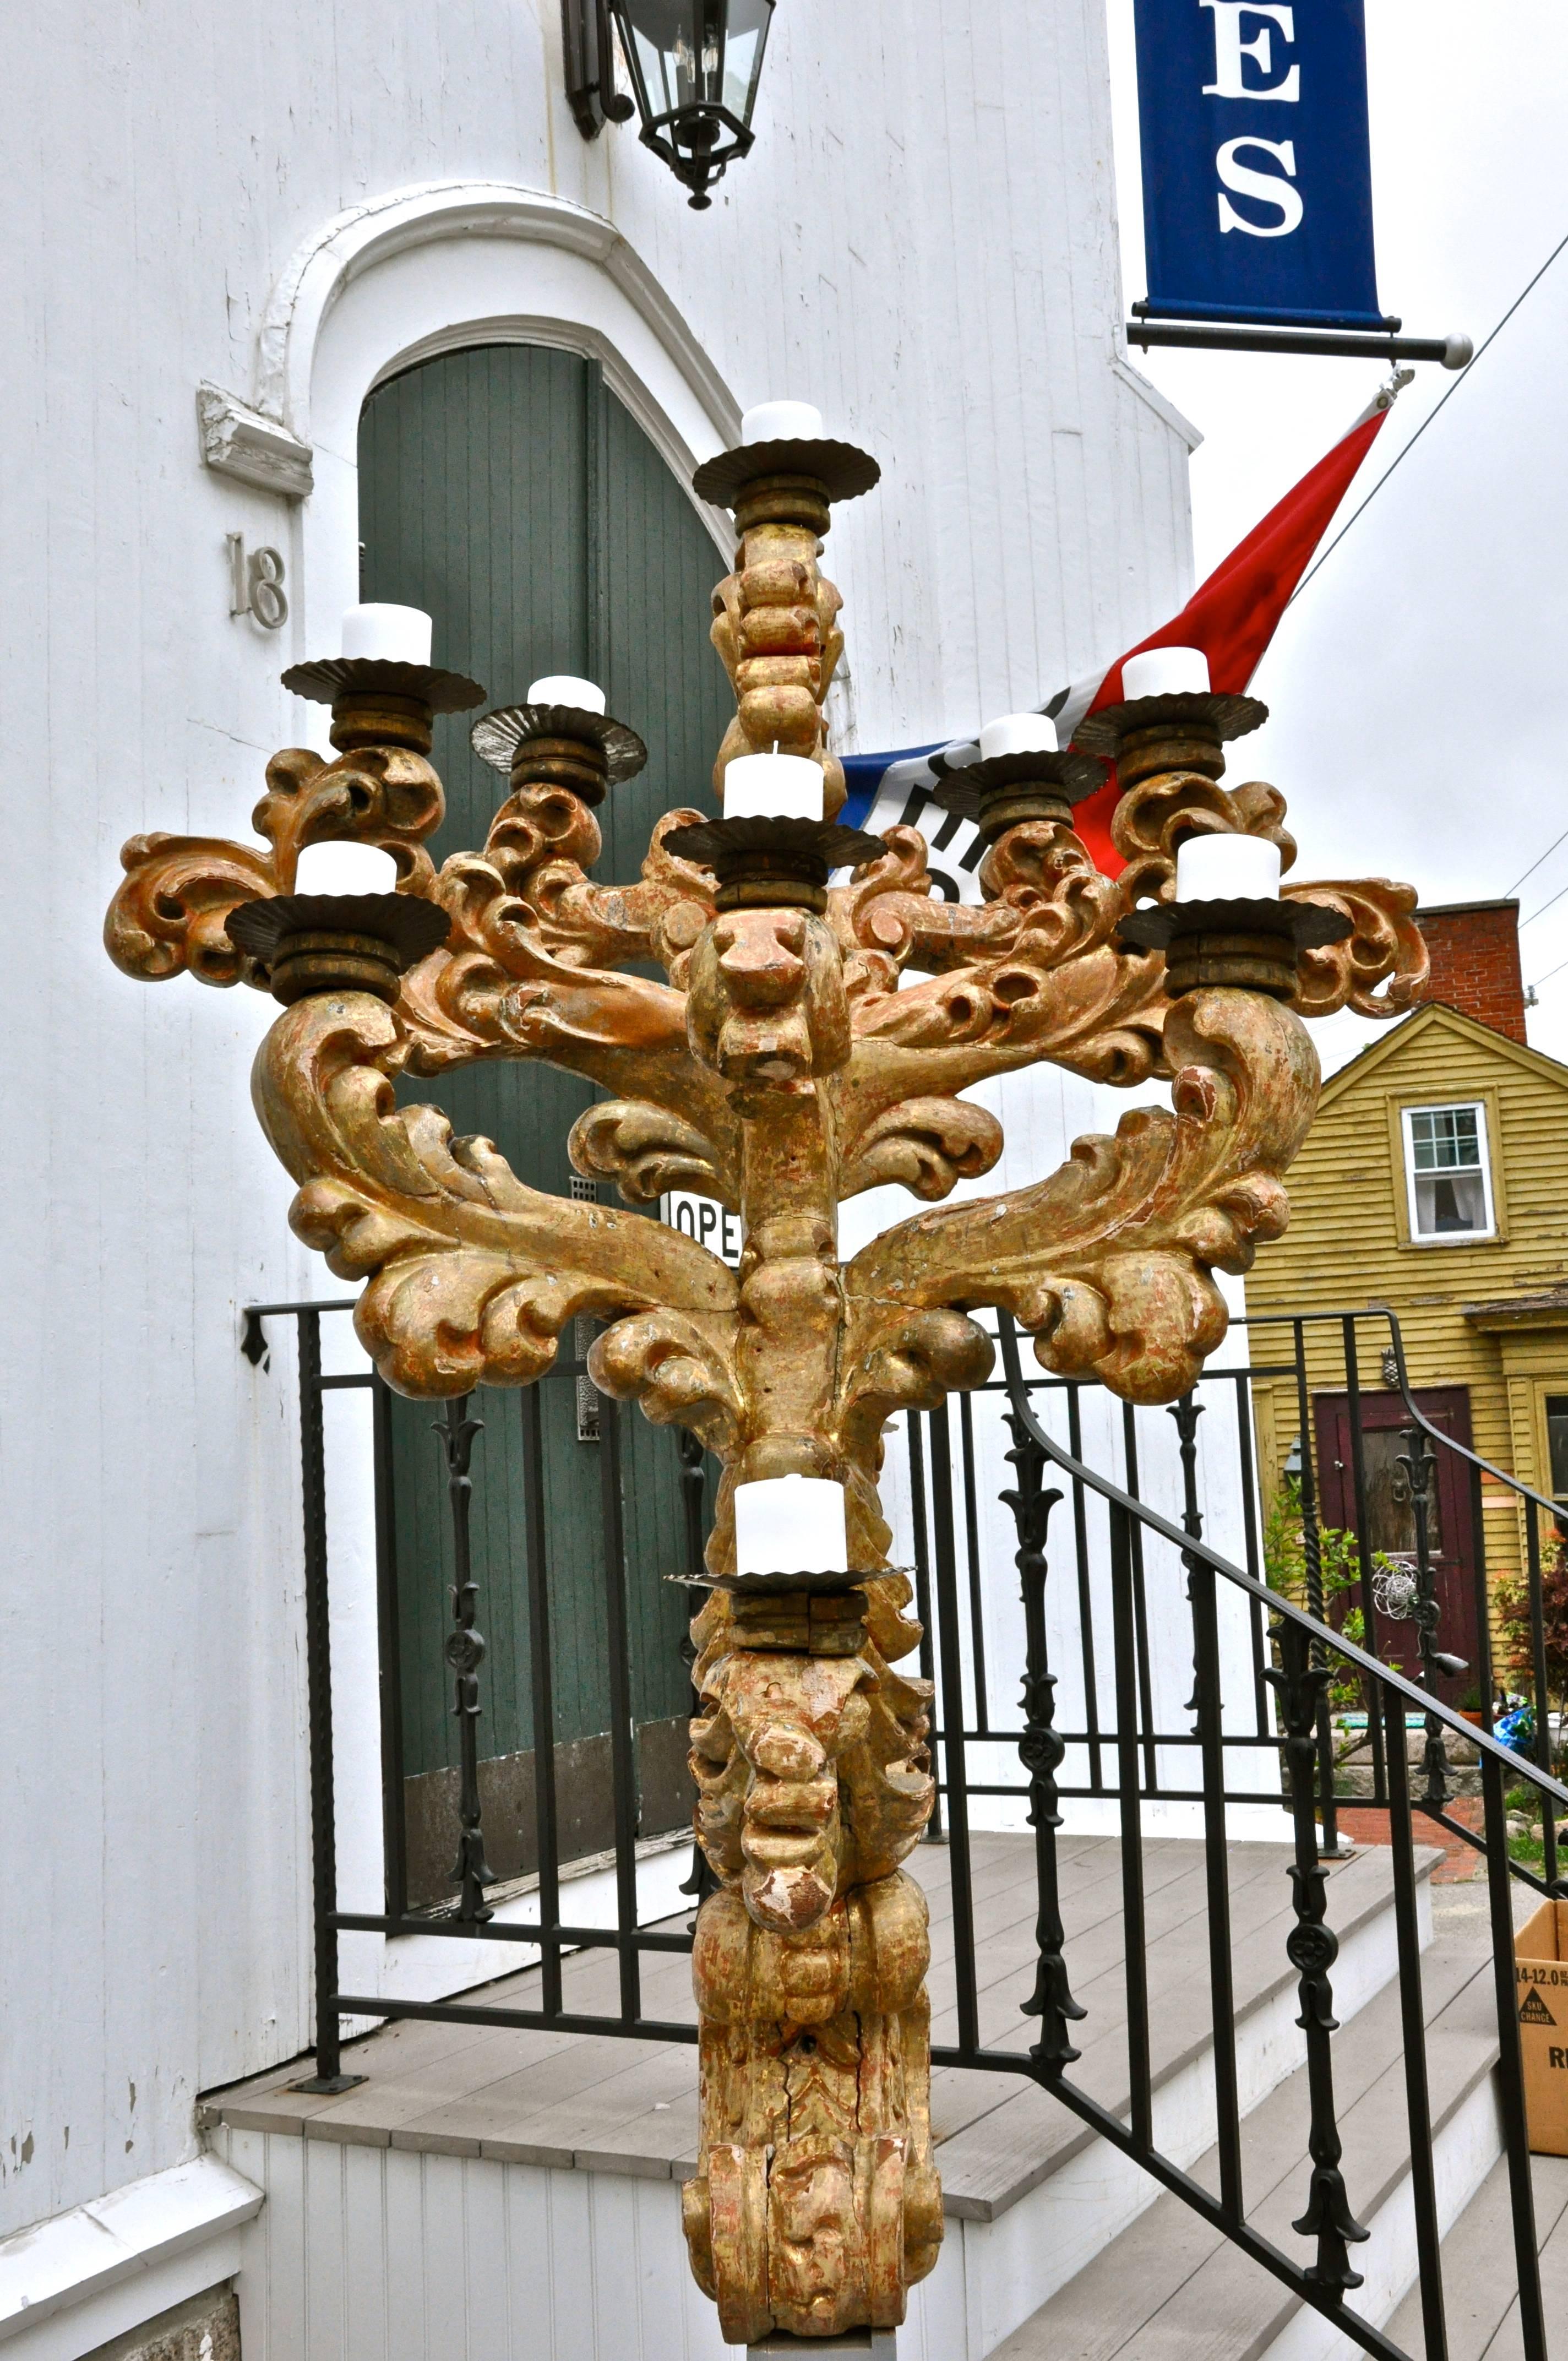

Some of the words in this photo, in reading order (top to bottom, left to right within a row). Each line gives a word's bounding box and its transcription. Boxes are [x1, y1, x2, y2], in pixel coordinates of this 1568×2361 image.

[226, 532, 288, 629] 18
[1527, 2001, 1542, 2011] SKU
[1521, 2011, 1550, 2023] CHANGE
